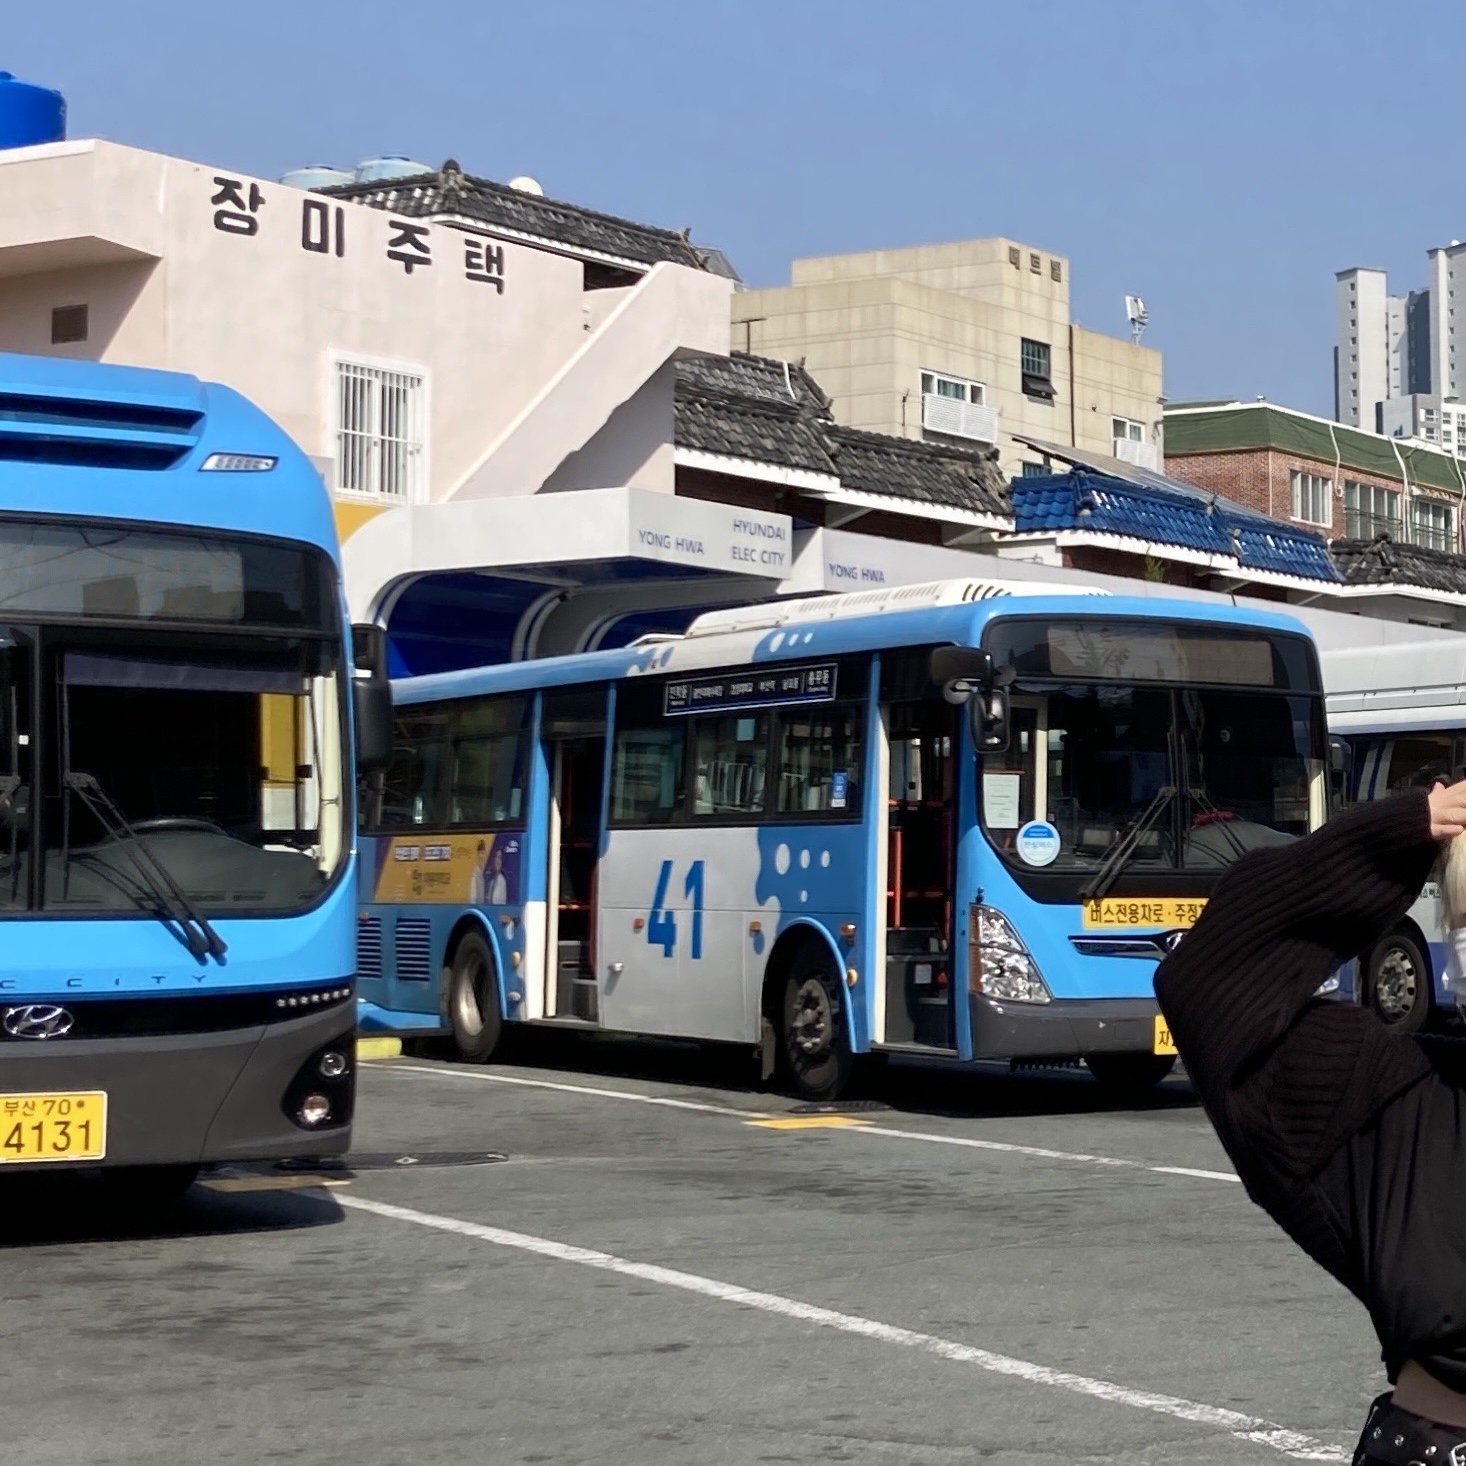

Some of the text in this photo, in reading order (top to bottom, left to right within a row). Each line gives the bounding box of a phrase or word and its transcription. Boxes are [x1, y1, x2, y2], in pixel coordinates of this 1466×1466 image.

[211, 176, 505, 295] 장미주택
[733, 518, 785, 541] HYUNDAI
[639, 530, 704, 555] YONG HWA
[732, 546, 784, 567] ELEC CITY
[829, 562, 886, 584] YONG HWA
[647, 860, 704, 959] 41
[1090, 901, 1164, 924] 버스전용차로
[4, 1099, 71, 1117] 부산 70
[4, 1120, 91, 1153] 4131
